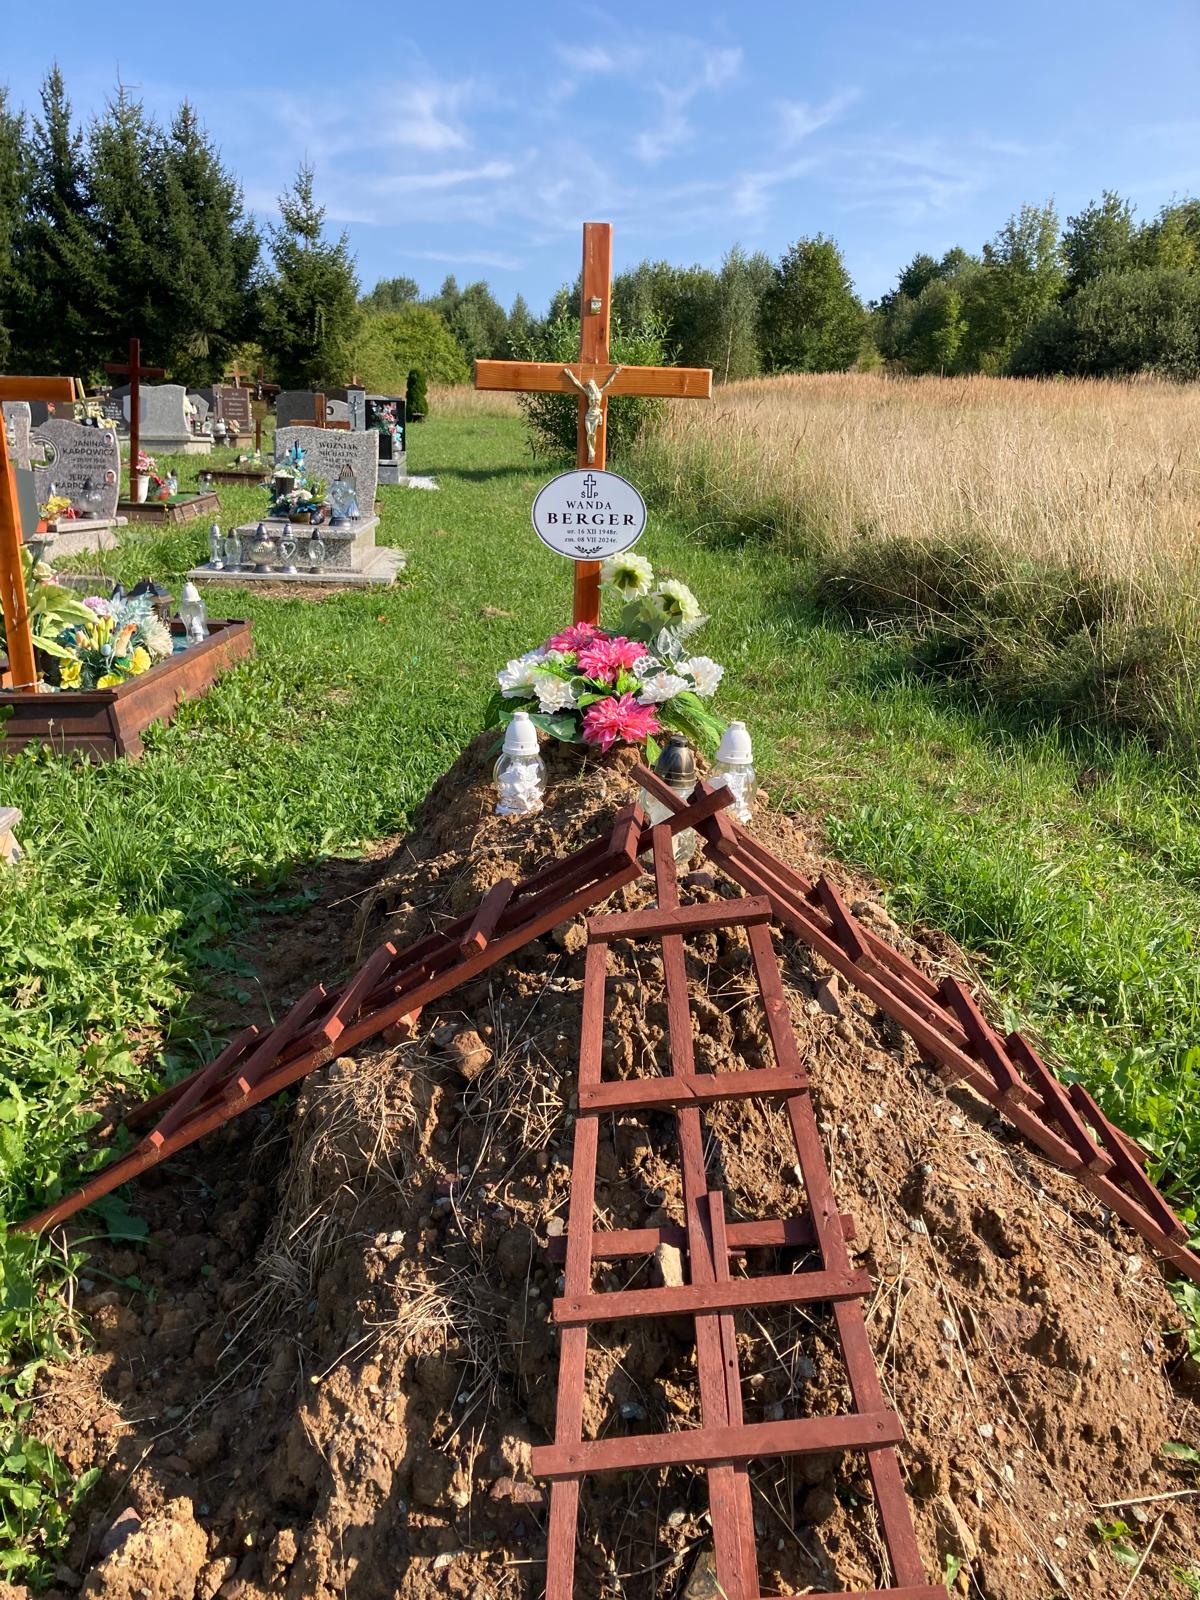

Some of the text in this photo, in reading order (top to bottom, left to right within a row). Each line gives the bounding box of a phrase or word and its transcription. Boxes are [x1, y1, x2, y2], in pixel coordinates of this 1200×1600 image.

[73, 440, 104, 448] JANINA
[62, 448, 114, 456] KARPOWICZ
[566, 500, 612, 510] WANDA
[547, 512, 635, 526] BERGER
